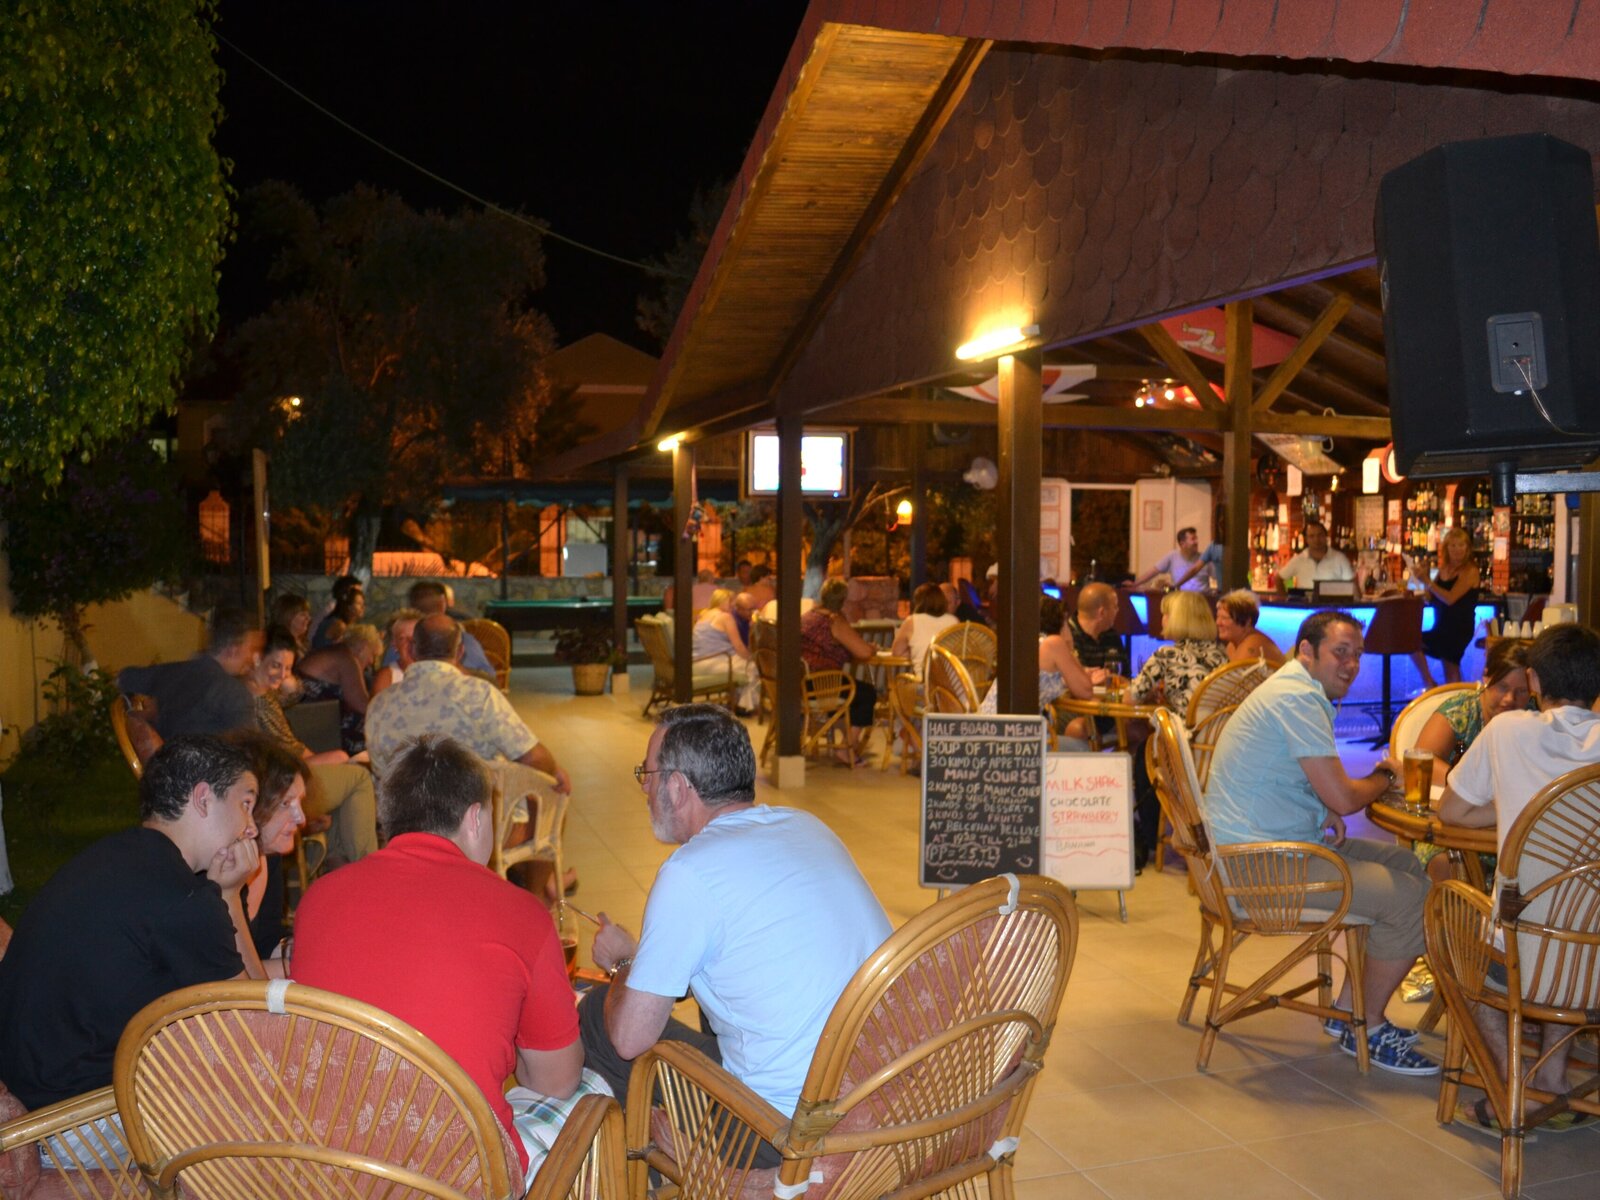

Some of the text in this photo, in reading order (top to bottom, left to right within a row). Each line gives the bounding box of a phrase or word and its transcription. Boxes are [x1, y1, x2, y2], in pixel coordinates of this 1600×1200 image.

[928, 722, 1041, 737] HALF BOARD MENU
[928, 741, 1039, 755] SOUP OF THE DAY
[972, 757, 987, 769] OF
[944, 768, 1037, 783] MAIN COURSE
[966, 783, 981, 794] OF
[1046, 777, 1083, 792] MILK
[1050, 796, 1112, 807] CHOCOLATE
[988, 814, 1024, 823] FRUITS
[1052, 810, 1119, 824] STRAWBERRY
[929, 821, 943, 830] AT
[933, 833, 948, 843] AT
[979, 834, 1003, 845] TILL
